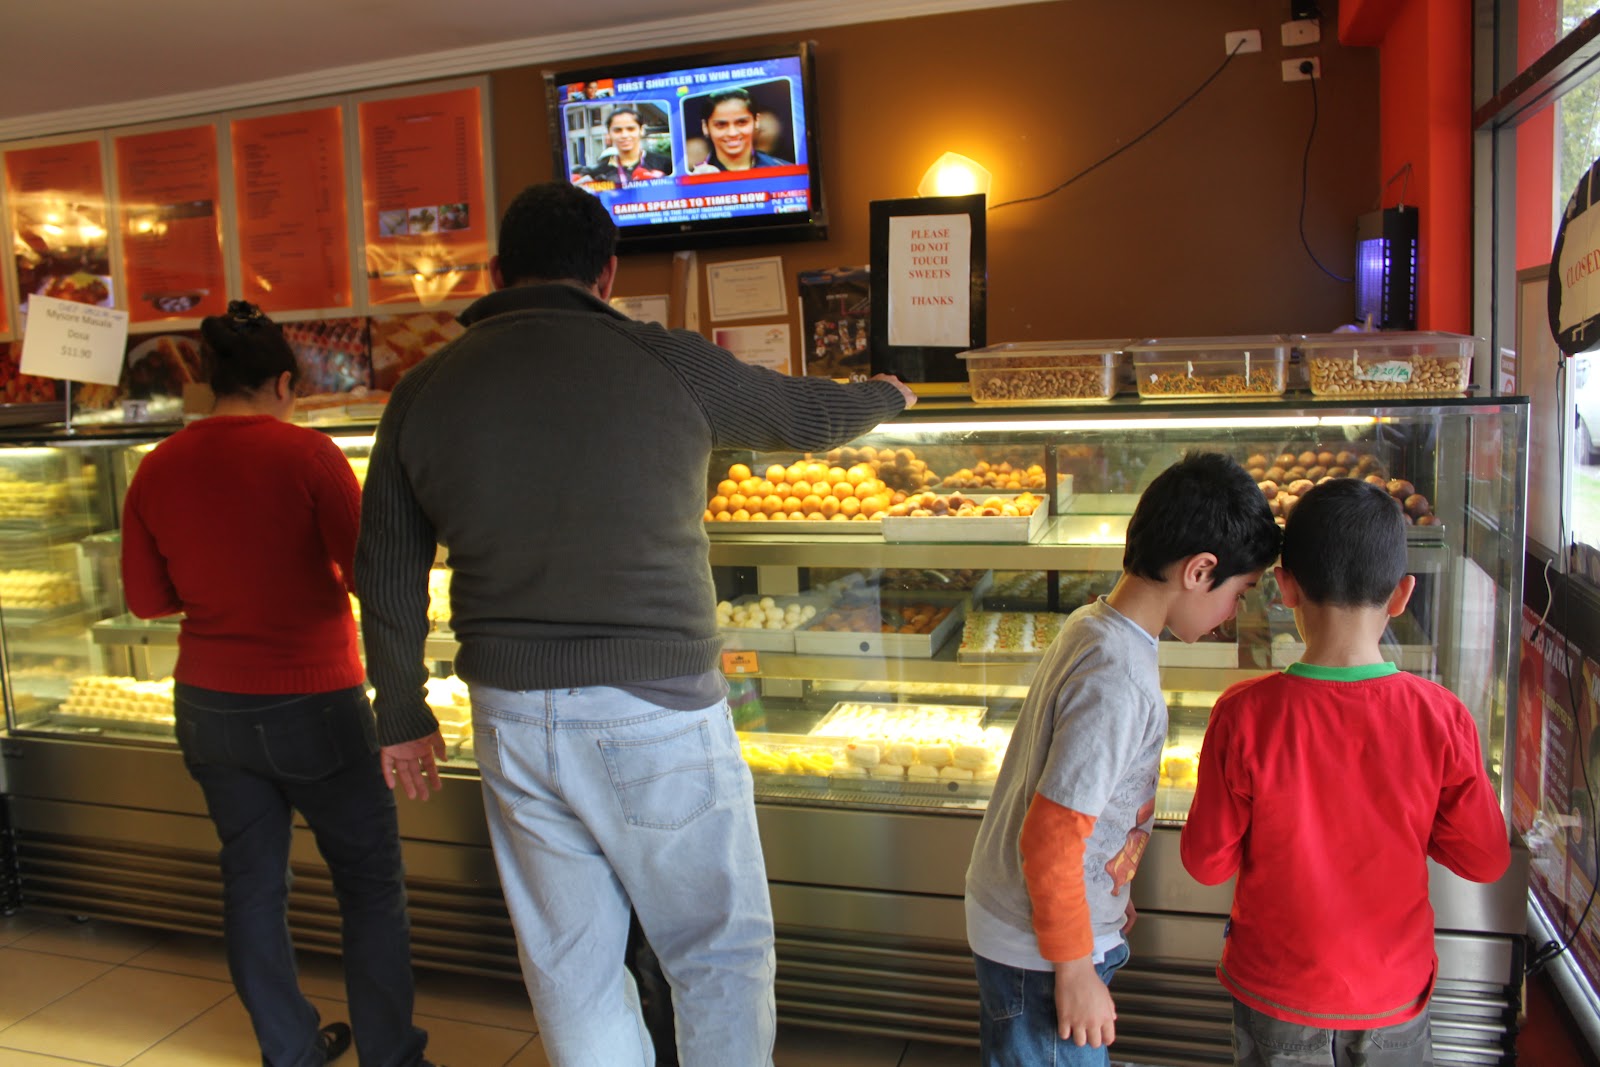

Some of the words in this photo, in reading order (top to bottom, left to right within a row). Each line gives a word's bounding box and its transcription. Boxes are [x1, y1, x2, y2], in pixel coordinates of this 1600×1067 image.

[617, 81, 644, 93] FIRST
[646, 75, 692, 89] SHUTTLER
[694, 73, 707, 83] TO
[708, 71, 730, 81] WIN
[731, 66, 766, 79] MEDAL
[614, 203, 646, 215] SAINA
[646, 198, 688, 212] SPEAKS
[688, 197, 703, 207] TO
[704, 194, 739, 207] TIMES
[740, 191, 766, 203] NOW
[911, 228, 950, 239] PLEASE
[911, 243, 926, 253] DO
[928, 242, 950, 252] NOT
[912, 256, 948, 266] TOUCH
[908, 269, 951, 279] SWEETS
[911, 296, 954, 306] THANKS
[46, 308, 80, 323] Mysore
[82, 315, 113, 328] Masala
[67, 329, 90, 340] Dosa
